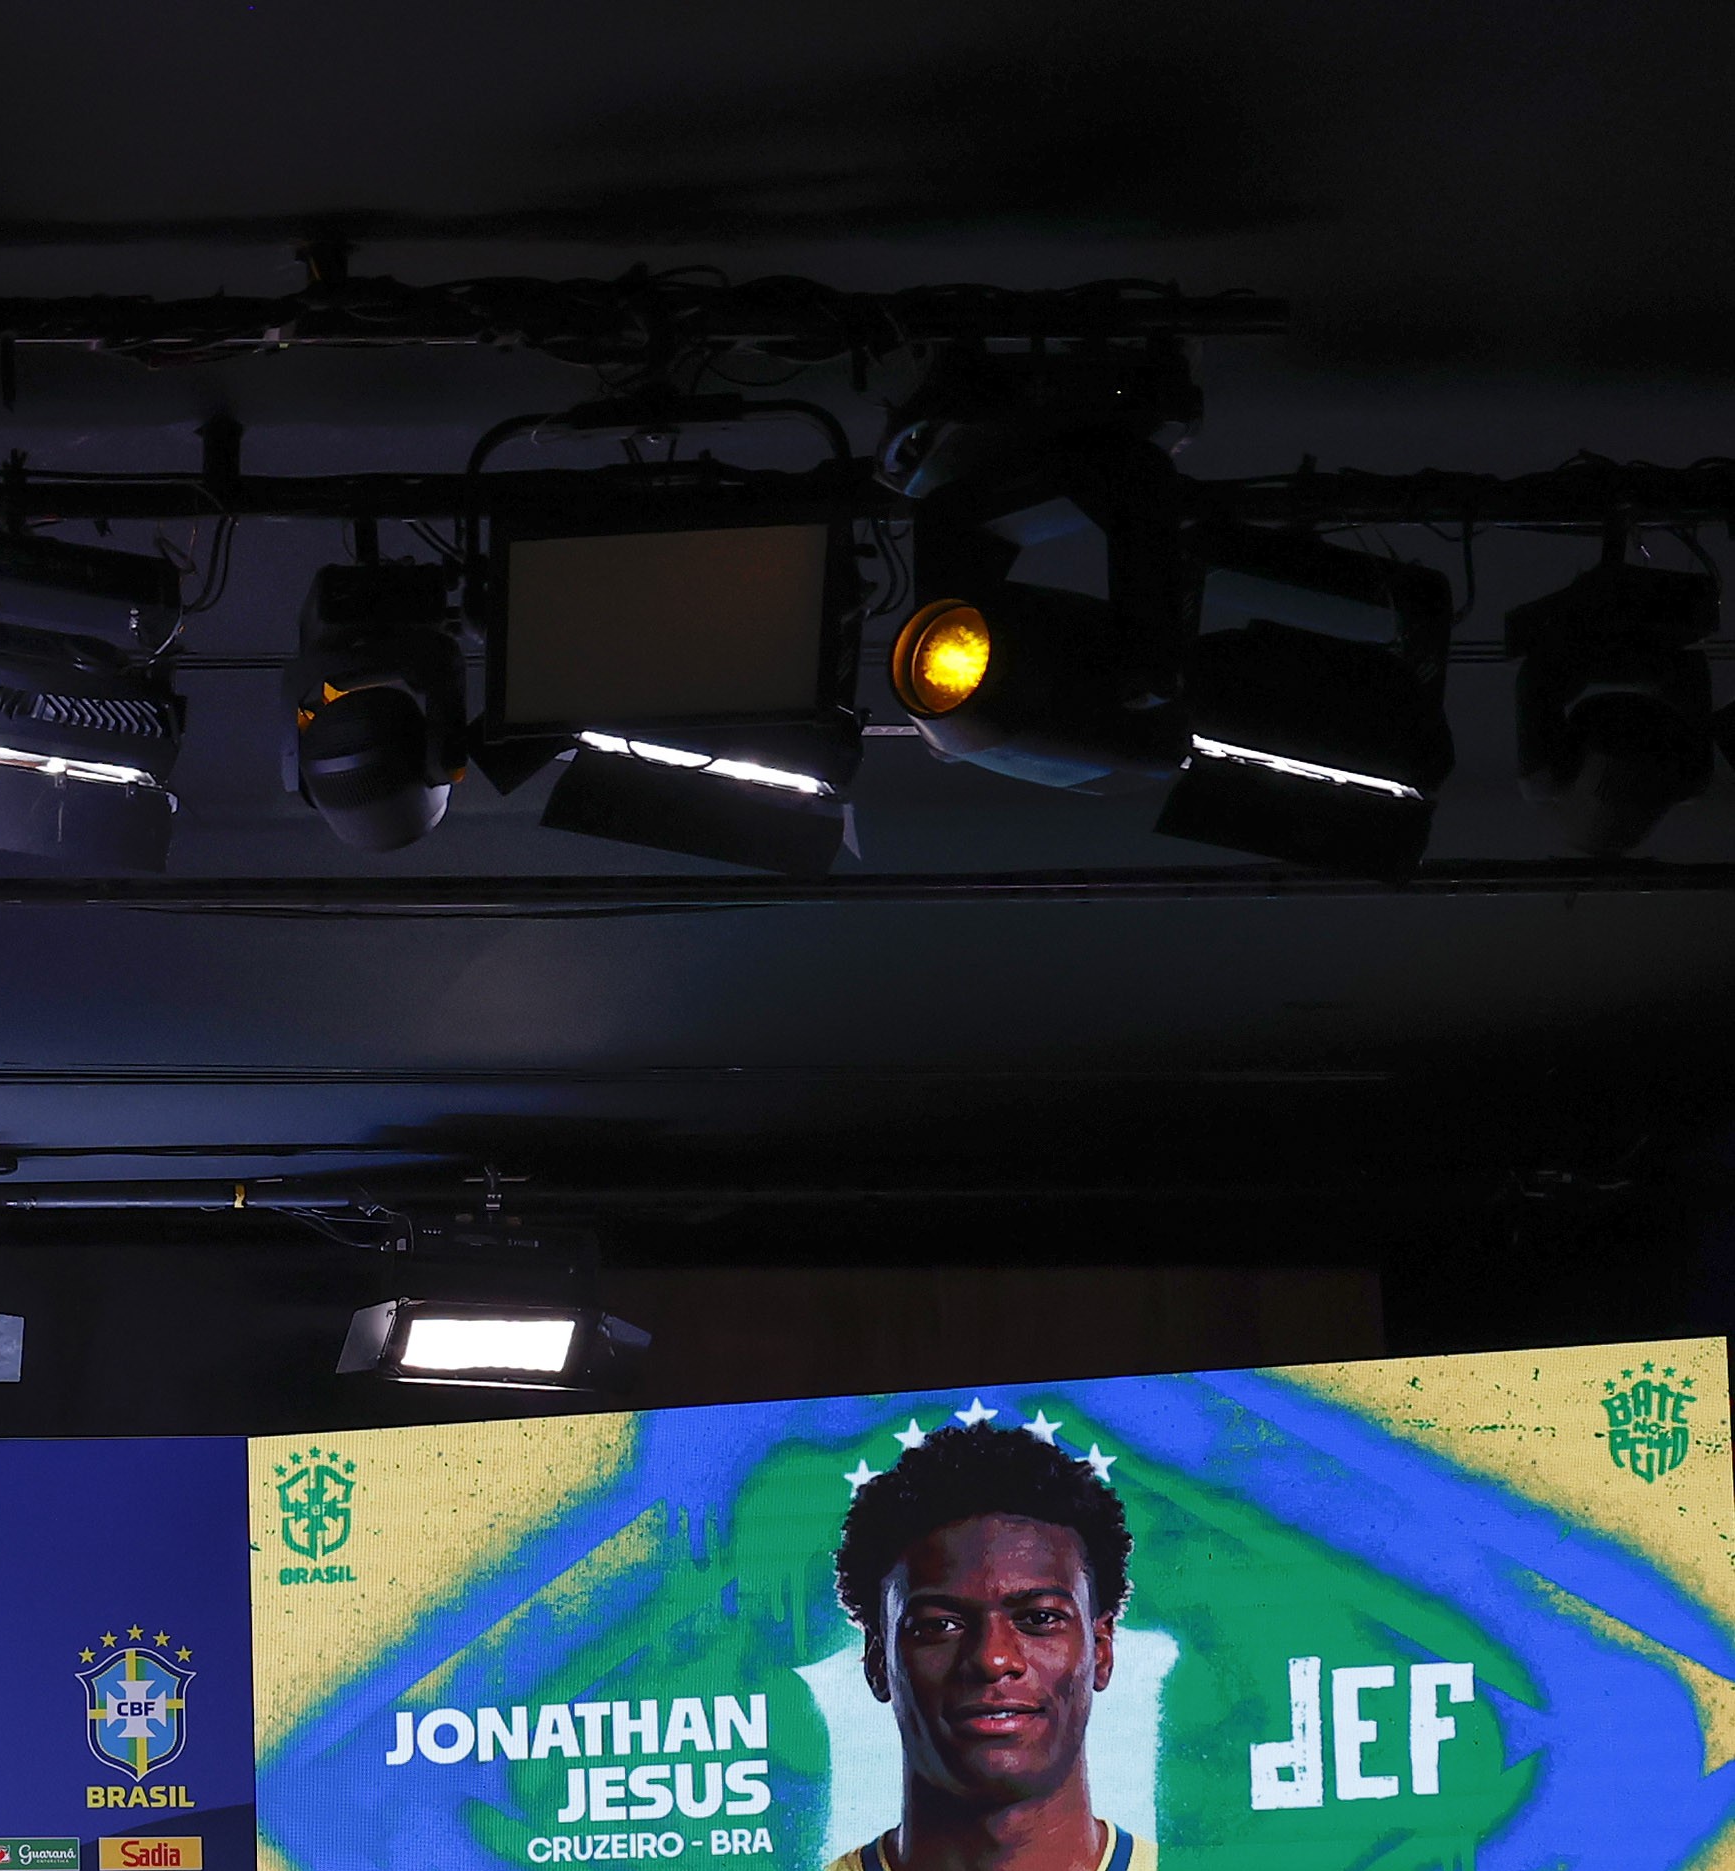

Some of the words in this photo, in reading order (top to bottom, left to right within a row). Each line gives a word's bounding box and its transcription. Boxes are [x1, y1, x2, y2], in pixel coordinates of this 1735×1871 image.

[1601, 1380, 1697, 1427] BATE
[280, 1565, 358, 1586] BRASIL
[117, 1702, 155, 1716] CBF
[386, 1694, 767, 1768] JONATHAN
[87, 1786, 194, 1807] BRASIL
[558, 1760, 770, 1822] JESUS
[17, 1843, 74, 1864] Guaraná
[121, 1841, 180, 1867] Sadia
[528, 1832, 684, 1863] CRUZEIRO
[711, 1828, 773, 1855] BRA
